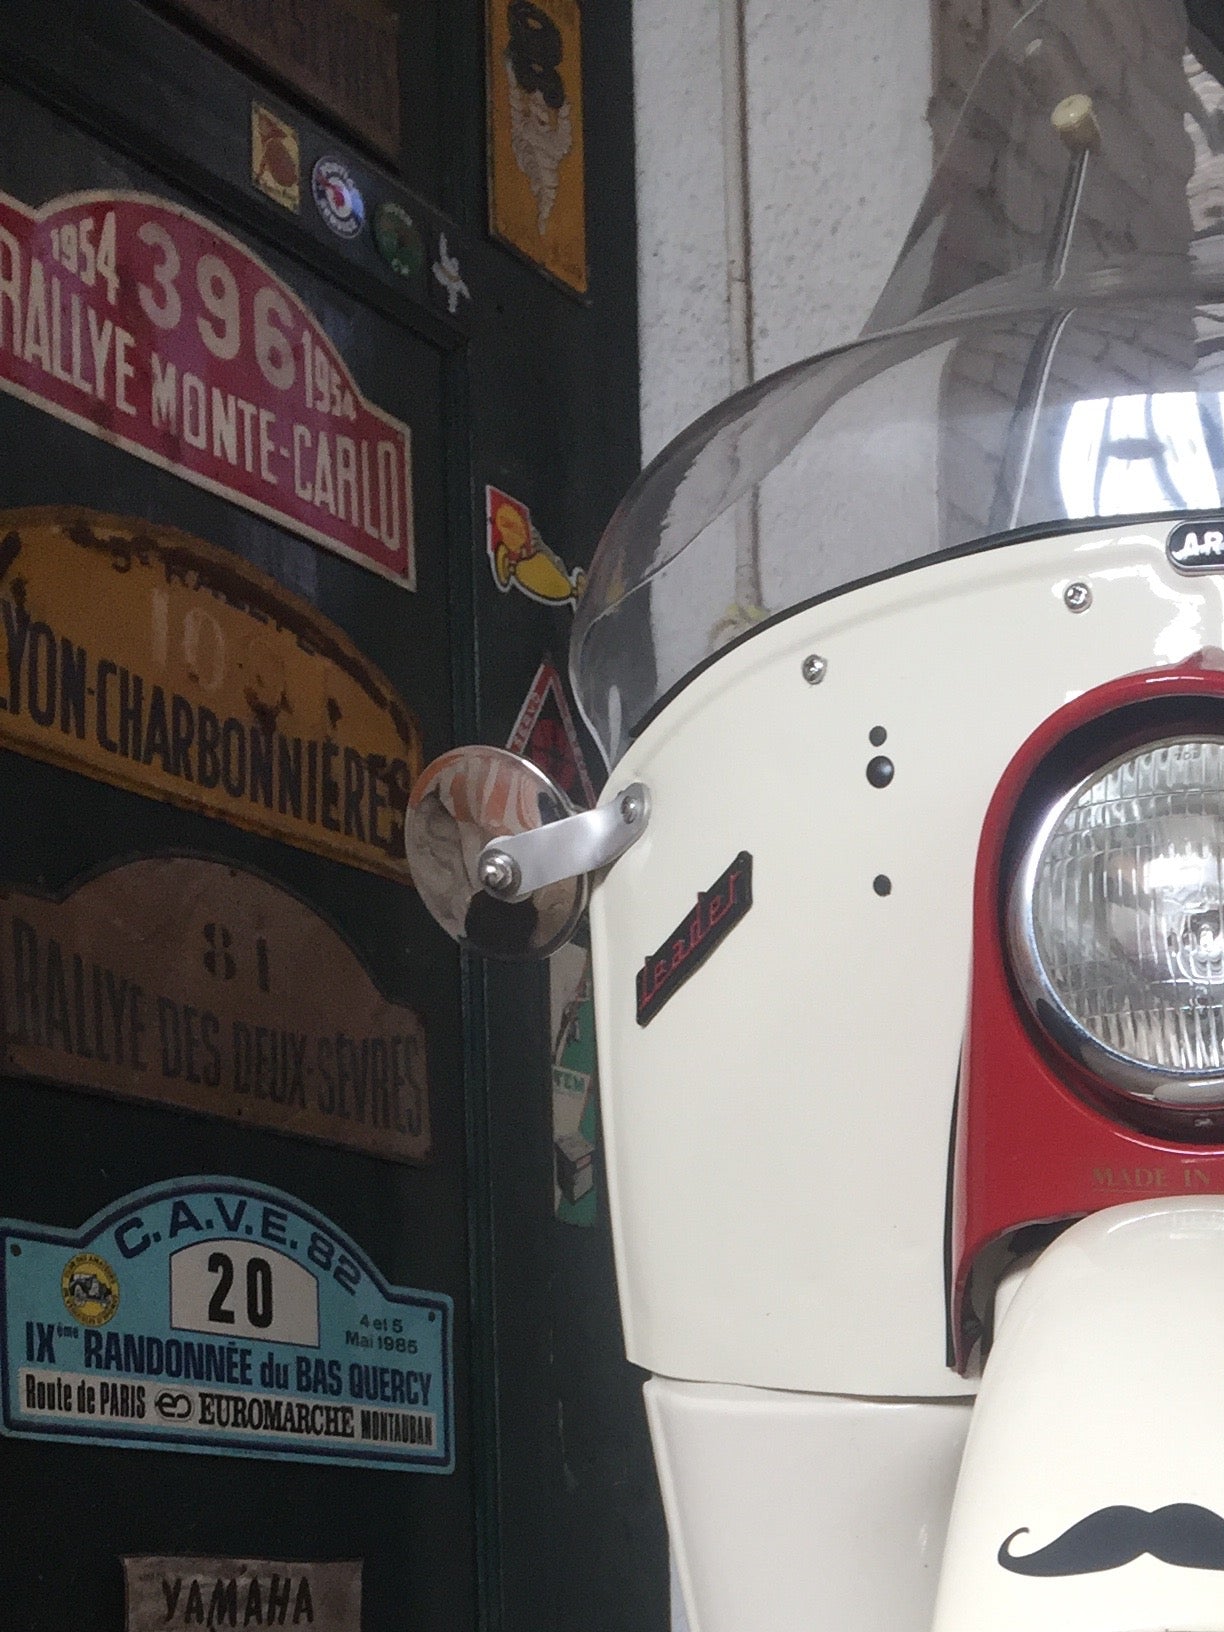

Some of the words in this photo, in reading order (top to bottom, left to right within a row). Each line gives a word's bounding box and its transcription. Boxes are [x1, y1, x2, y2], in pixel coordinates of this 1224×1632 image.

[50, 211, 119, 305] 1954
[137, 221, 296, 391] 396
[0, 230, 137, 415] RALLYE
[151, 352, 400, 551] MONTE-CARLO
[301, 330, 356, 419] 1954
[203, 923, 270, 992] 81
[639, 871, 741, 1014] Leader
[12, 916, 147, 1071] RALLYE
[159, 996, 220, 1087] DES
[1092, 1167, 1168, 1187] MADE
[1183, 1168, 1210, 1187] IN
[114, 1197, 298, 1258] C.A.V.E.
[308, 1232, 361, 1296] 82
[207, 1253, 273, 1328] 20
[360, 1314, 369, 1328] 4
[373, 1318, 388, 1331] et
[84, 1328, 252, 1386] RANDONNÉE
[260, 1352, 289, 1390] du
[296, 1356, 342, 1396] BAS
[350, 1363, 432, 1405] QUERCY
[345, 1330, 373, 1349] Mai
[26, 1374, 72, 1412] Route
[77, 1379, 95, 1414] de
[100, 1382, 145, 1419] PARIS
[361, 1410, 432, 1446] MONTAUBAN
[162, 1573, 314, 1628] YAMAHA
